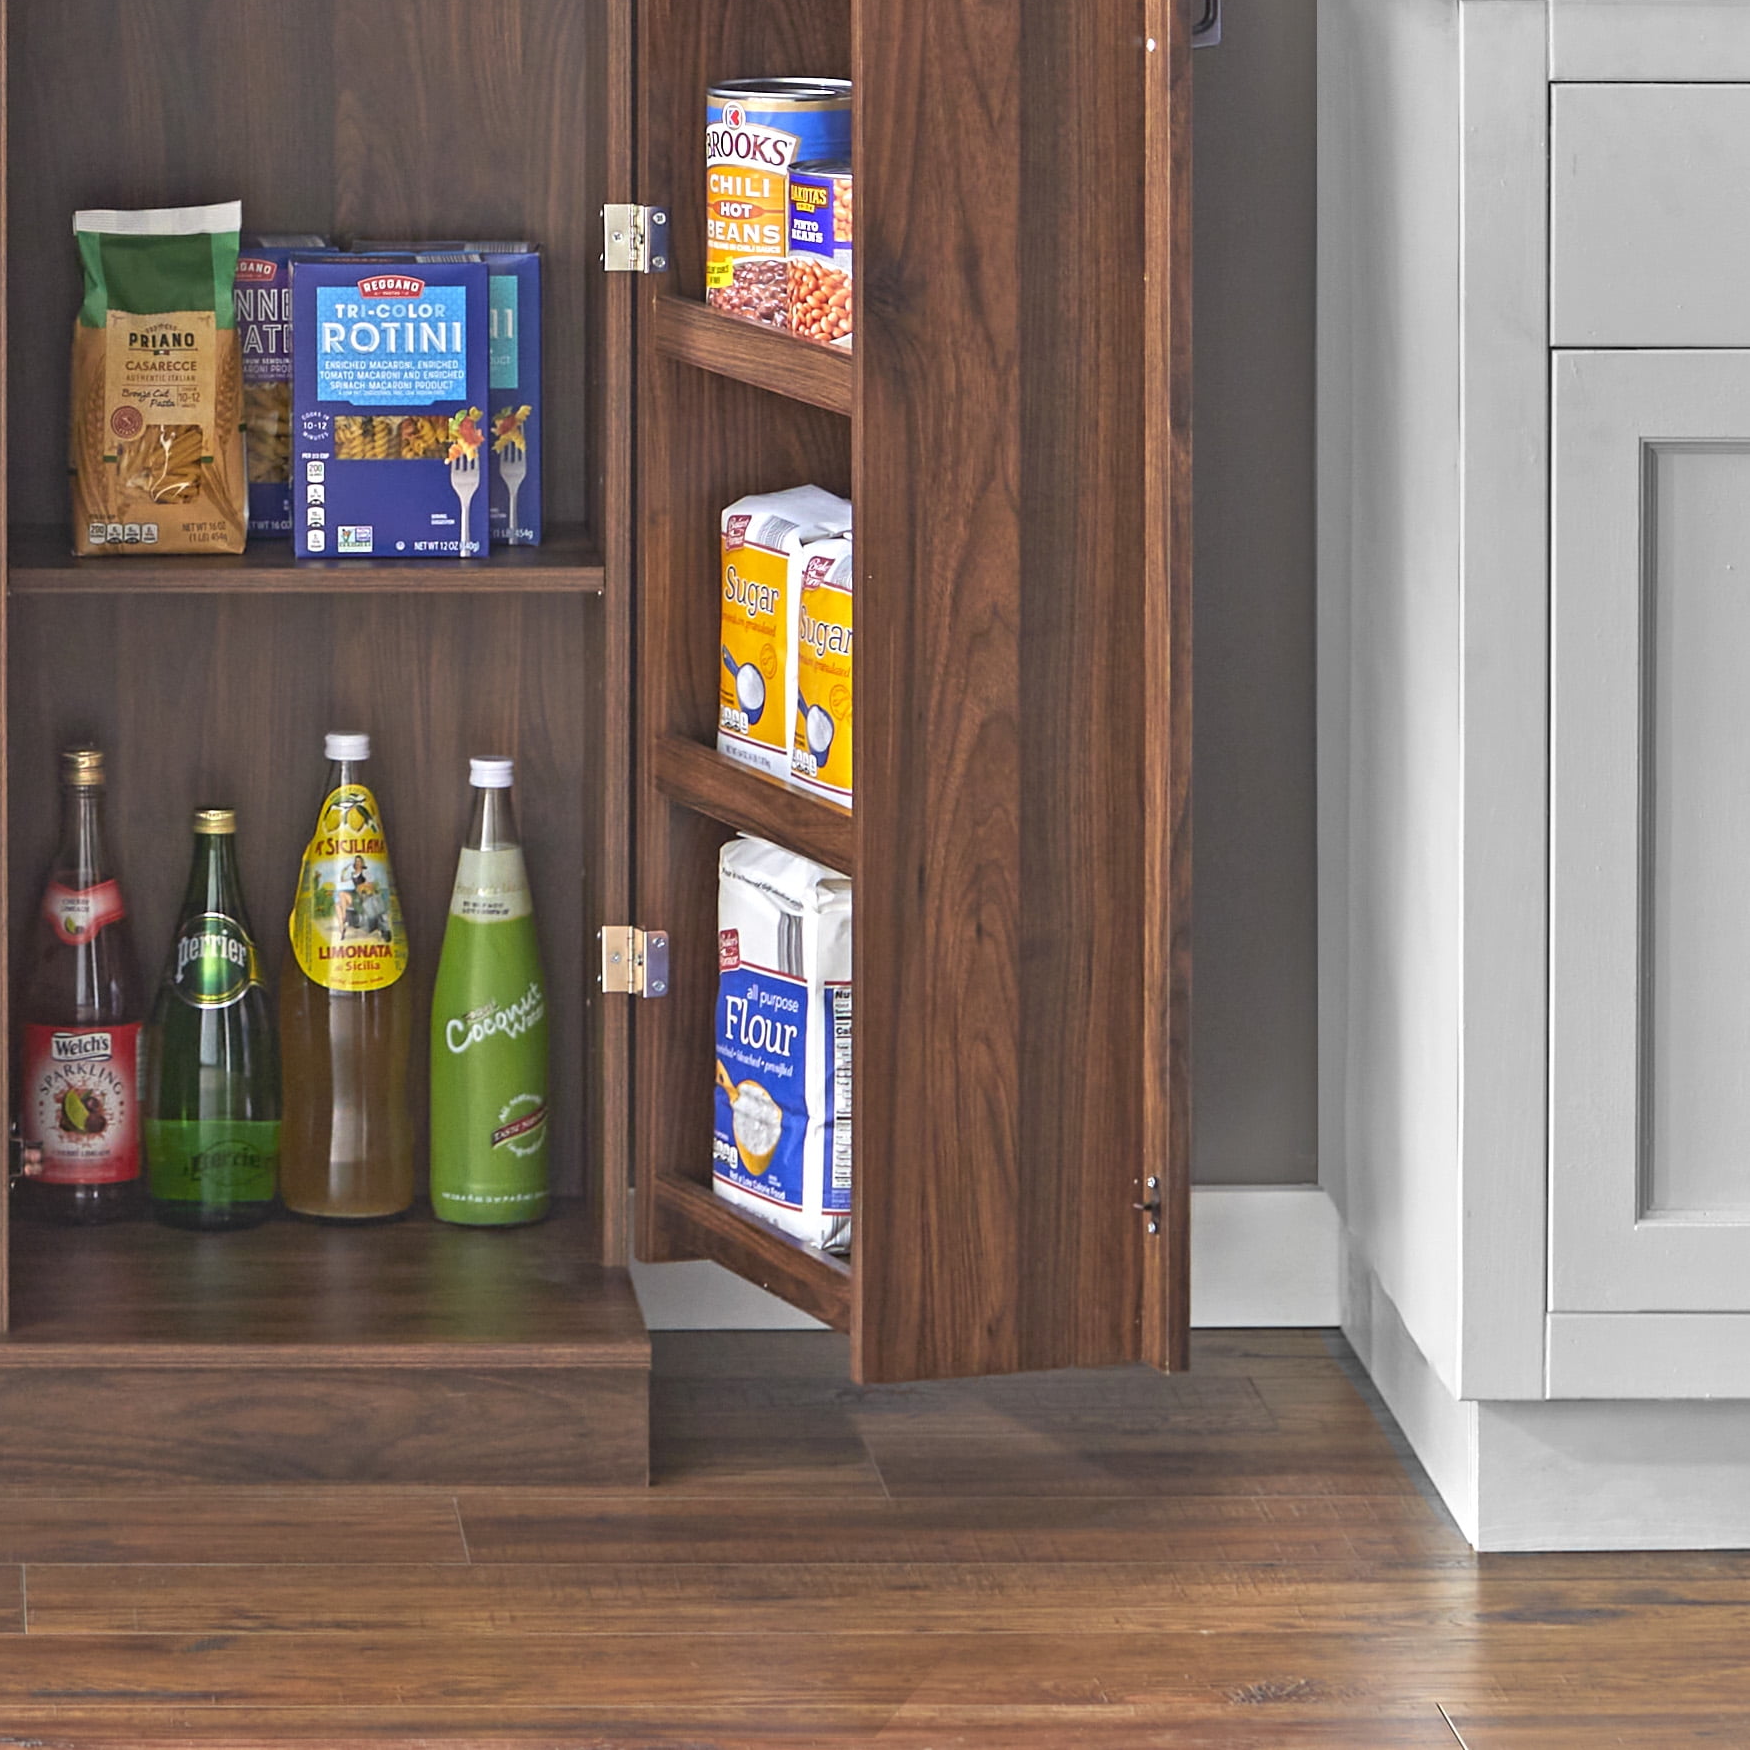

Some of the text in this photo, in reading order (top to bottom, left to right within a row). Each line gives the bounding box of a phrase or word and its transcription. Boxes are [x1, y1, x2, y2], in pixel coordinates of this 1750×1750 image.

[710, 174, 770, 197] CHILI
[720, 202, 752, 218] HOT
[708, 220, 781, 244] BEANS
[793, 219, 819, 232] PINTO
[792, 229, 823, 244] BEANS
[363, 279, 419, 293] REGGANO
[335, 303, 446, 319] TRI-COLOR
[129, 332, 195, 348] PRIANO
[322, 321, 462, 355] ROTINI
[125, 361, 197, 371] CASARECCE
[325, 361, 366, 370] ENRICHED
[417, 360, 459, 369] ENRICHED
[320, 371, 465, 379] TOMATO MACARONI AND ENRICHED
[330, 381, 454, 390] SPINACH MACARONI PRODUCT
[150, 399, 175, 408] Pasta
[303, 422, 327, 430] 10-12
[414, 542, 458, 550] NET WT 12 OZ
[725, 566, 779, 616] Sugar
[318, 945, 392, 960] LIMONATA
[346, 961, 380, 971] Sicilia
[747, 984, 799, 1013] all purpose
[446, 982, 542, 1053] Coconut
[725, 995, 798, 1057] Flour
[55, 1036, 109, 1056] Welch's
[40, 1063, 123, 1095] SPARKLING
